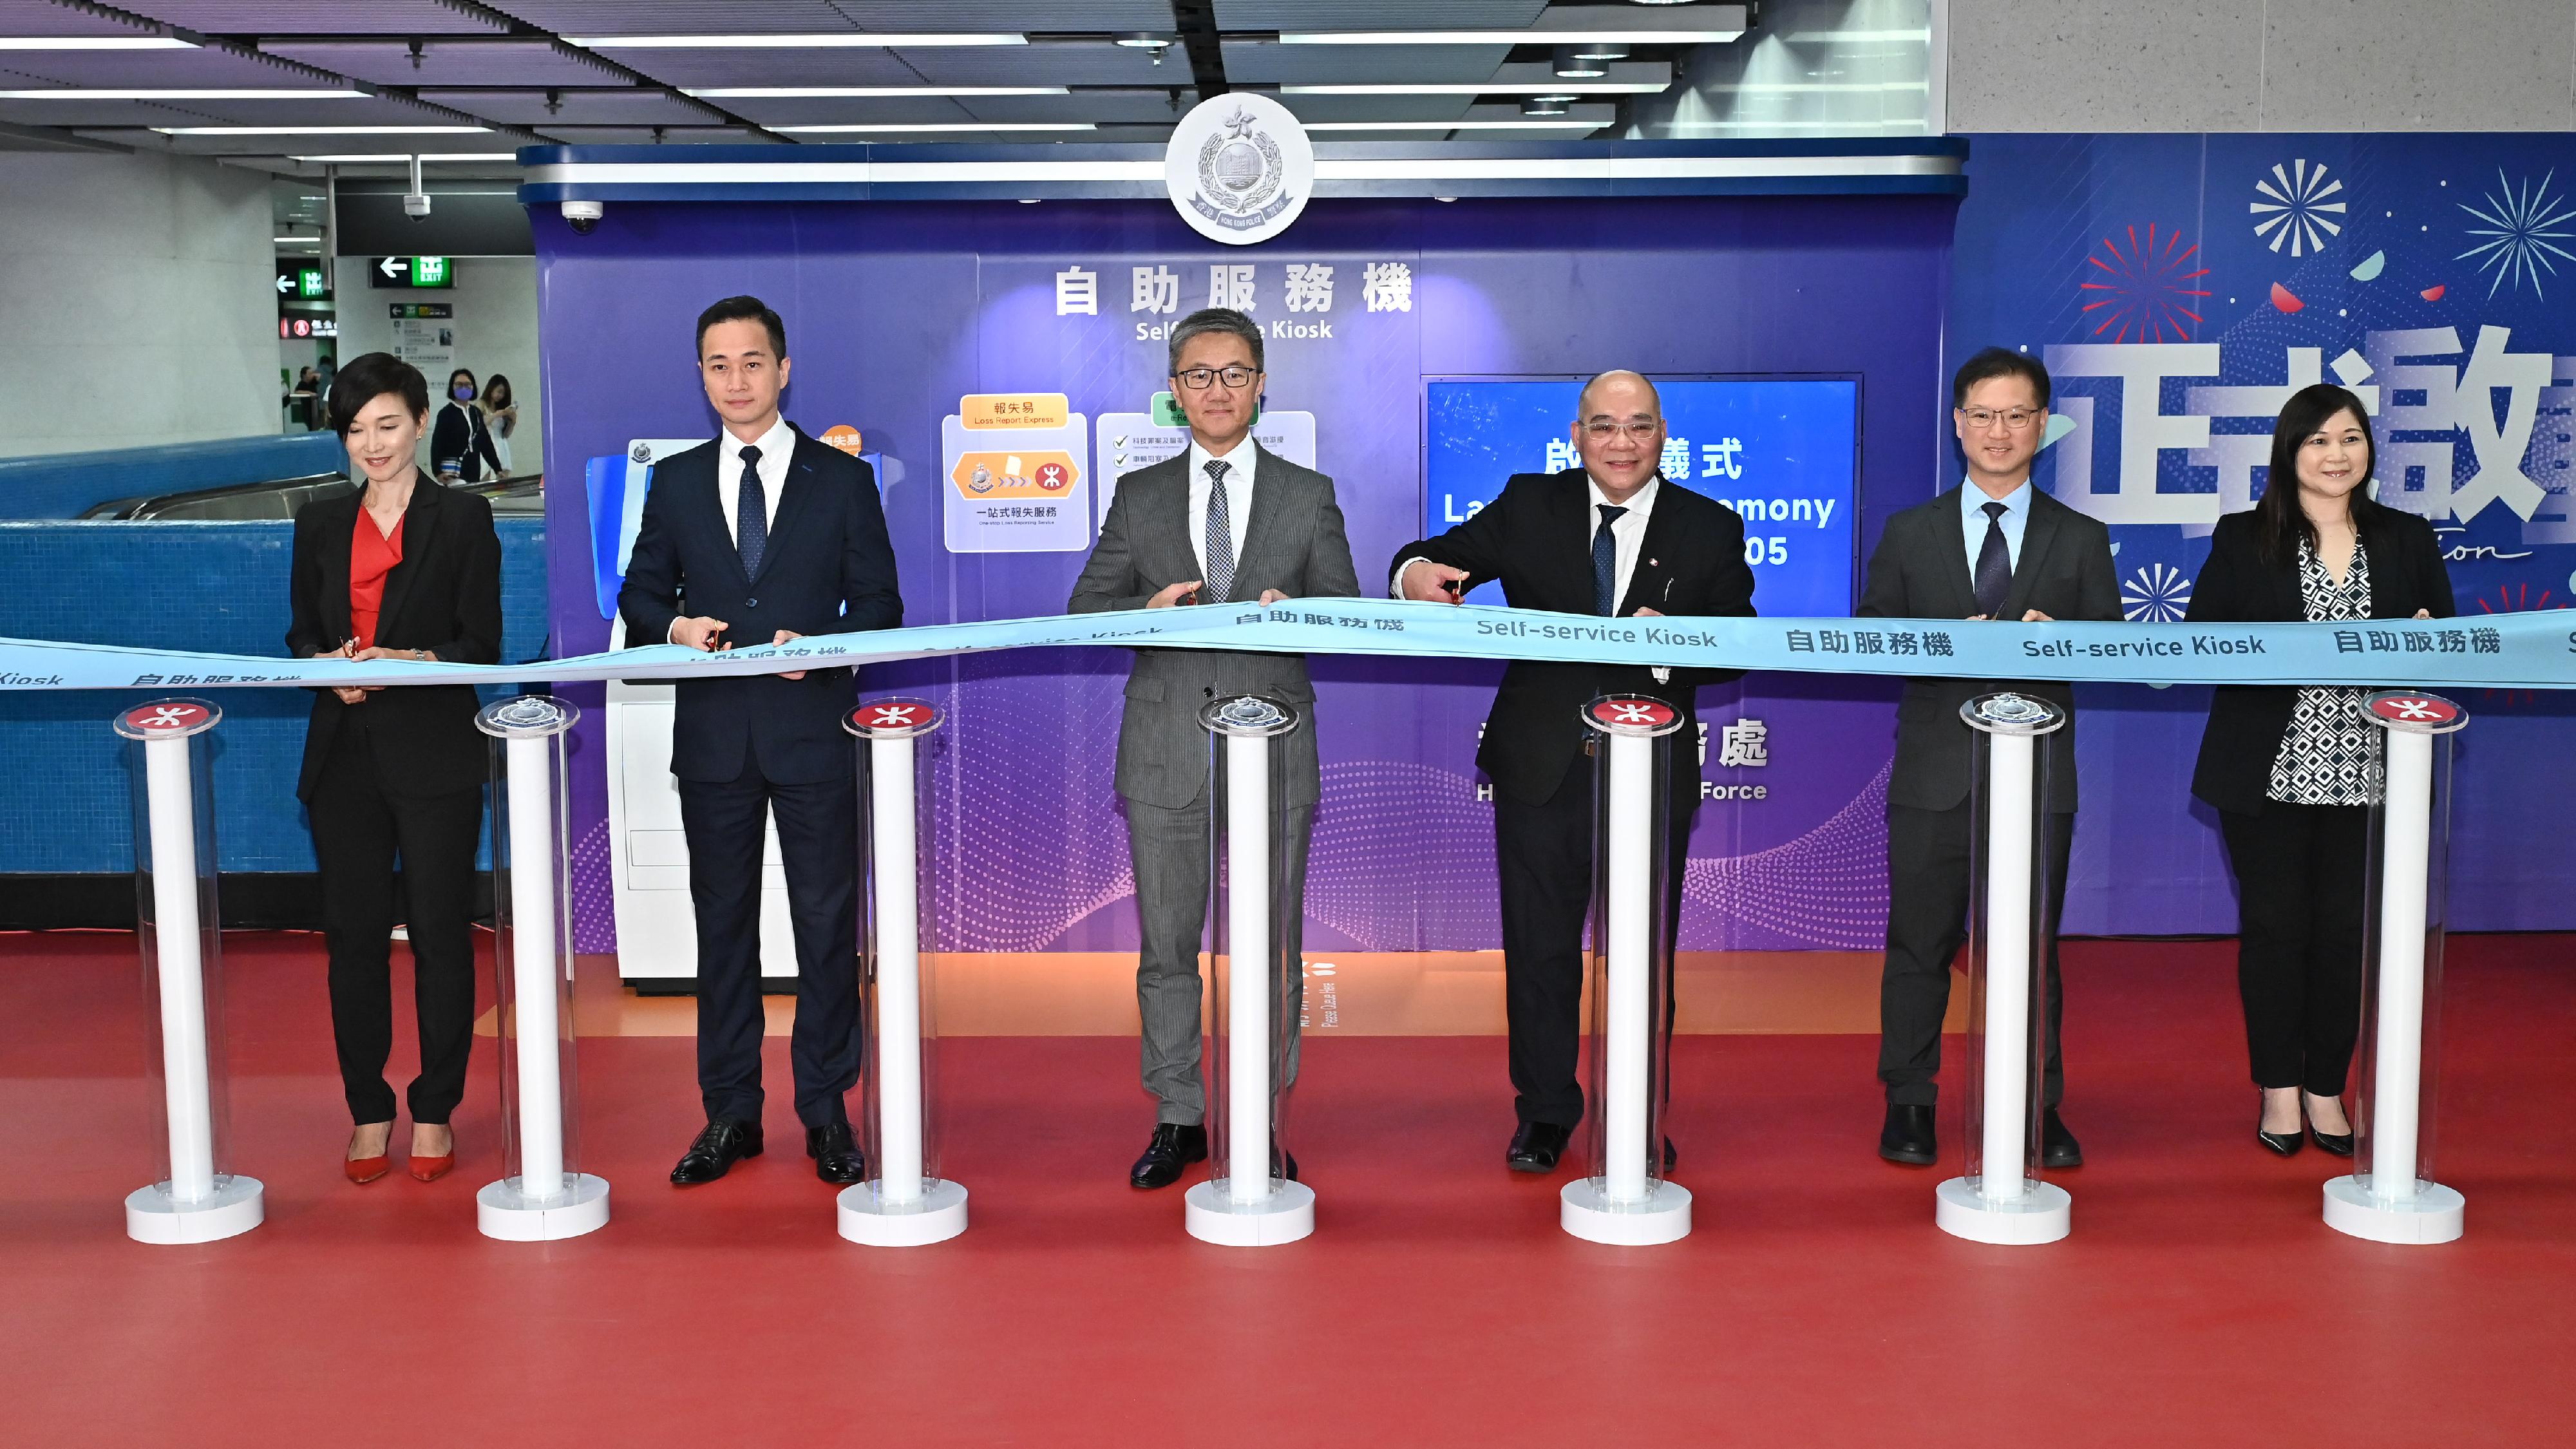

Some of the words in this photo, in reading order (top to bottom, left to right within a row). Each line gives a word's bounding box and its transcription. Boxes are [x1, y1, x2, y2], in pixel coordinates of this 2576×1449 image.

[1221, 216, 1233, 226] HONG
[1246, 216, 1260, 226] POLICE
[421, 273, 441, 281] EXIT
[1056, 263, 1412, 316] 自助服務機
[1273, 320, 1332, 338] Kiosk
[994, 401, 1034, 414] 報失易
[1024, 416, 1054, 424] Express
[976, 506, 1057, 518] 一站式報失服務
[1477, 620, 1636, 642] Self-service
[1645, 627, 1718, 647] Kiosk
[1786, 629, 1954, 656] 自助服務機
[2334, 627, 2501, 653] 自助服務機
[2023, 636, 2183, 657] Self-service
[2192, 635, 2266, 655] Kiosk
[1701, 781, 1767, 800] Force
